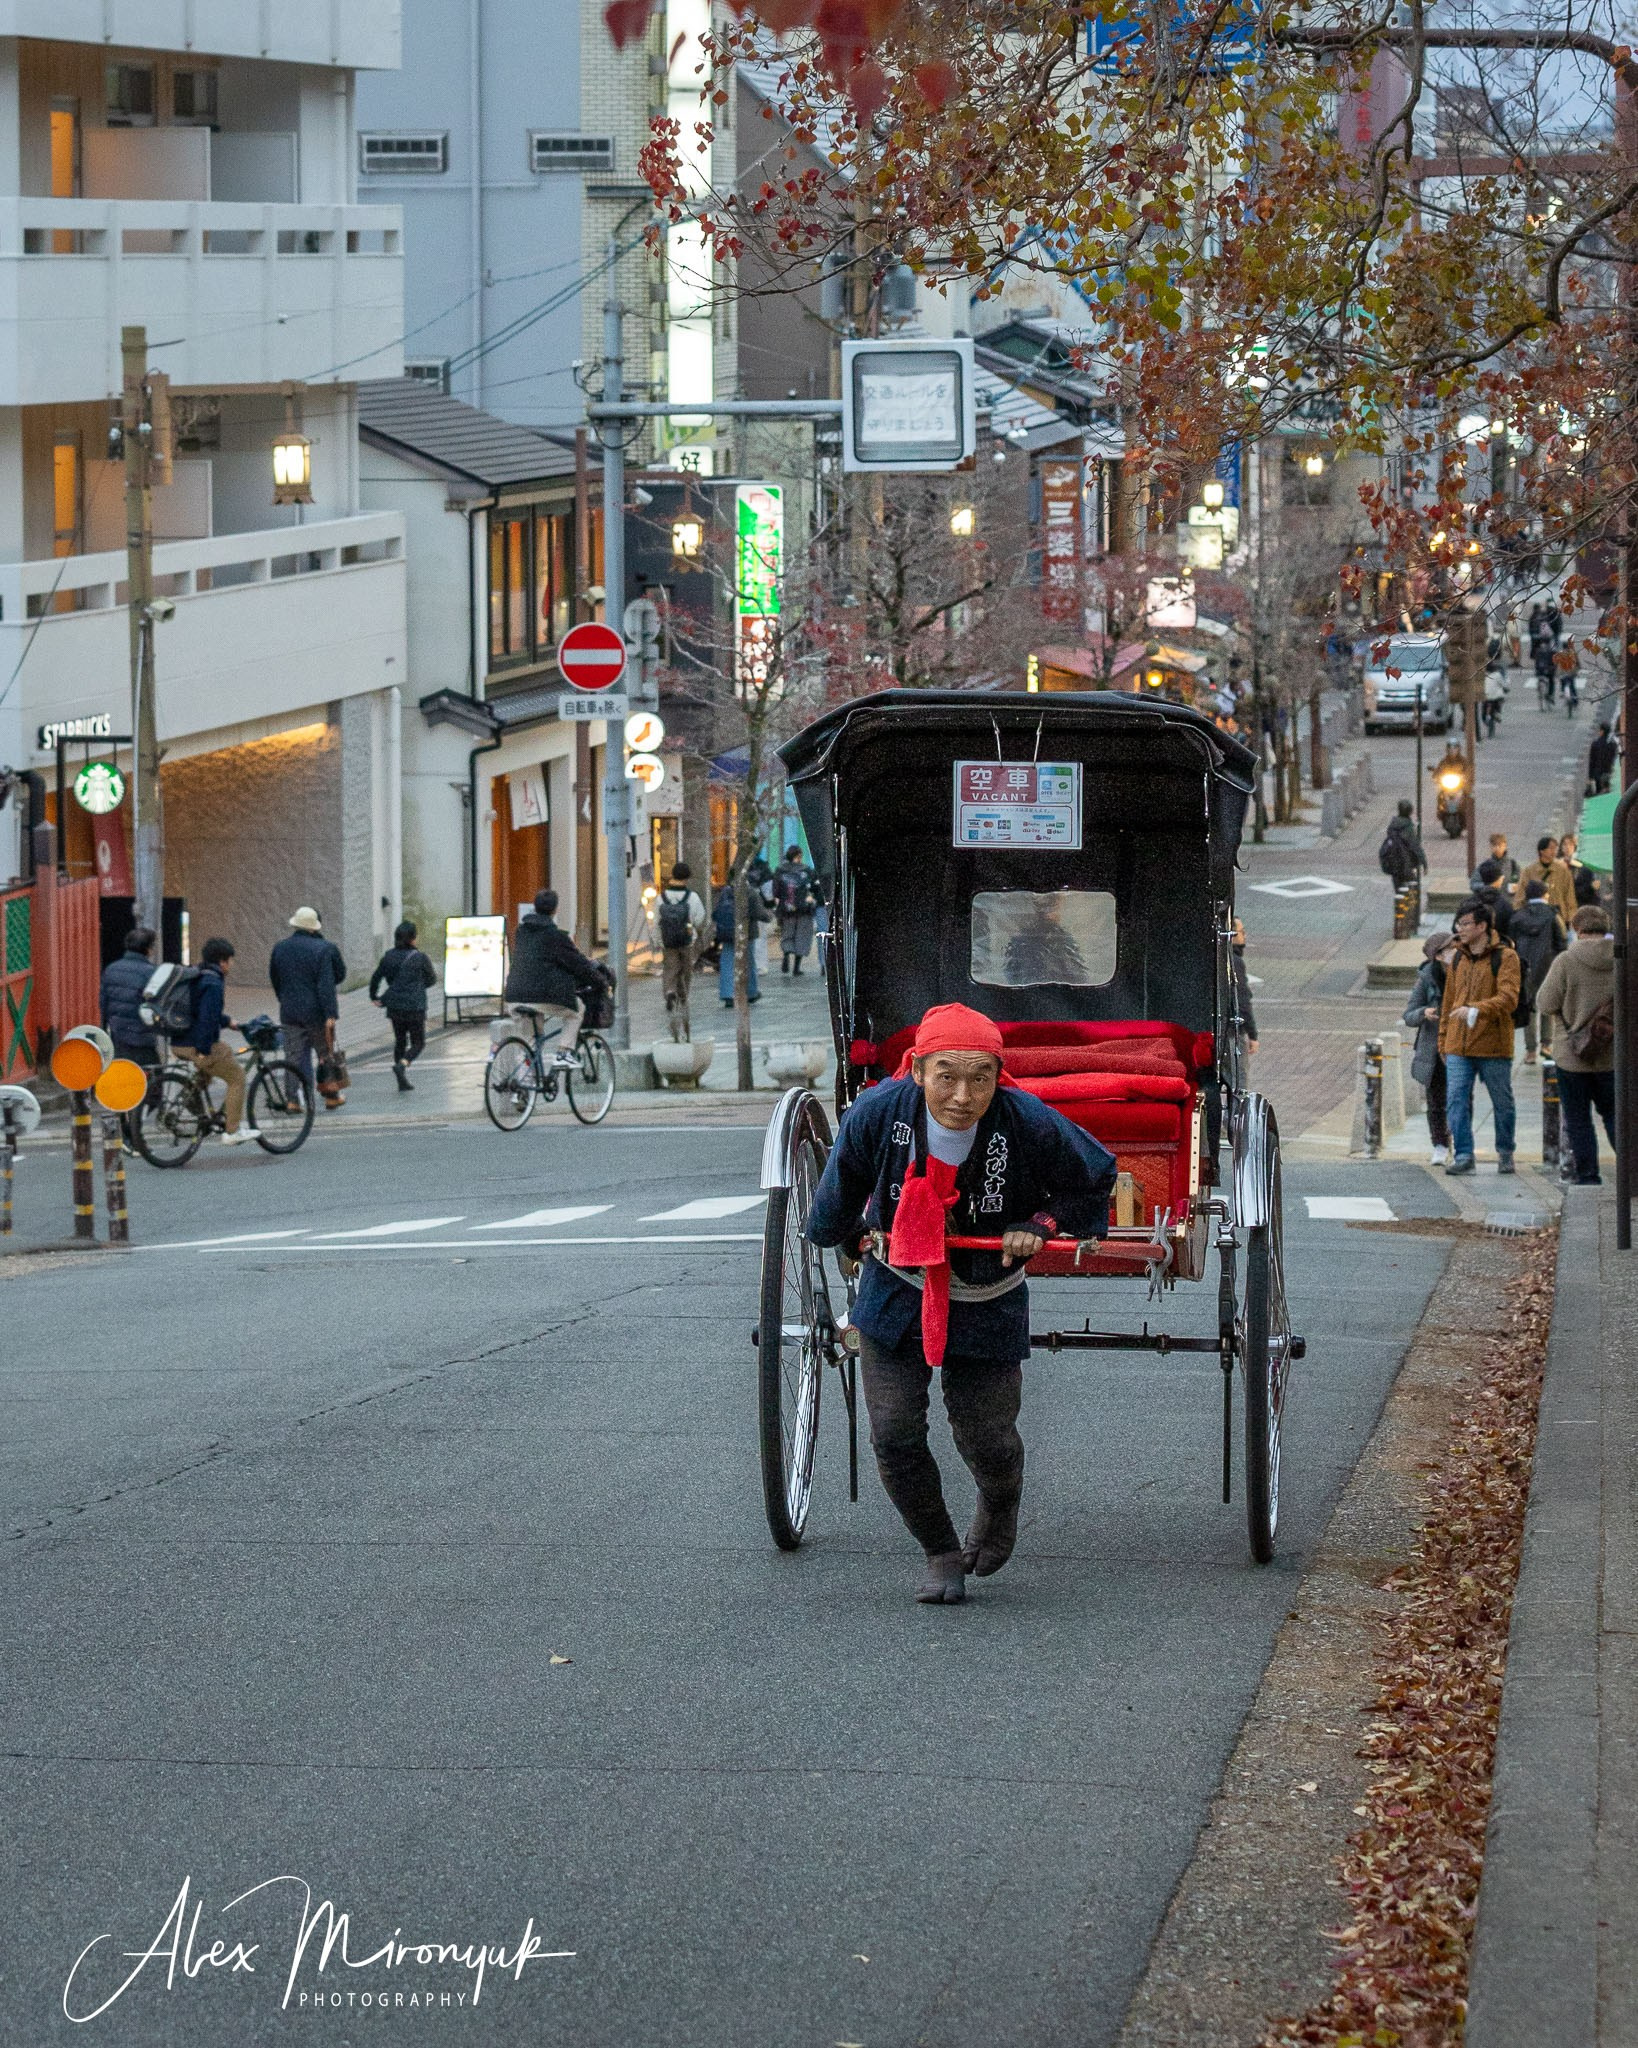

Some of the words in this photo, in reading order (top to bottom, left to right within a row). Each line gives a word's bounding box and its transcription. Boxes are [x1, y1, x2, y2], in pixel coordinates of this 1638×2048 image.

[565, 701, 622, 715] 自転車を除く
[970, 768, 1030, 791] 空車
[972, 793, 1028, 801] VACANT
